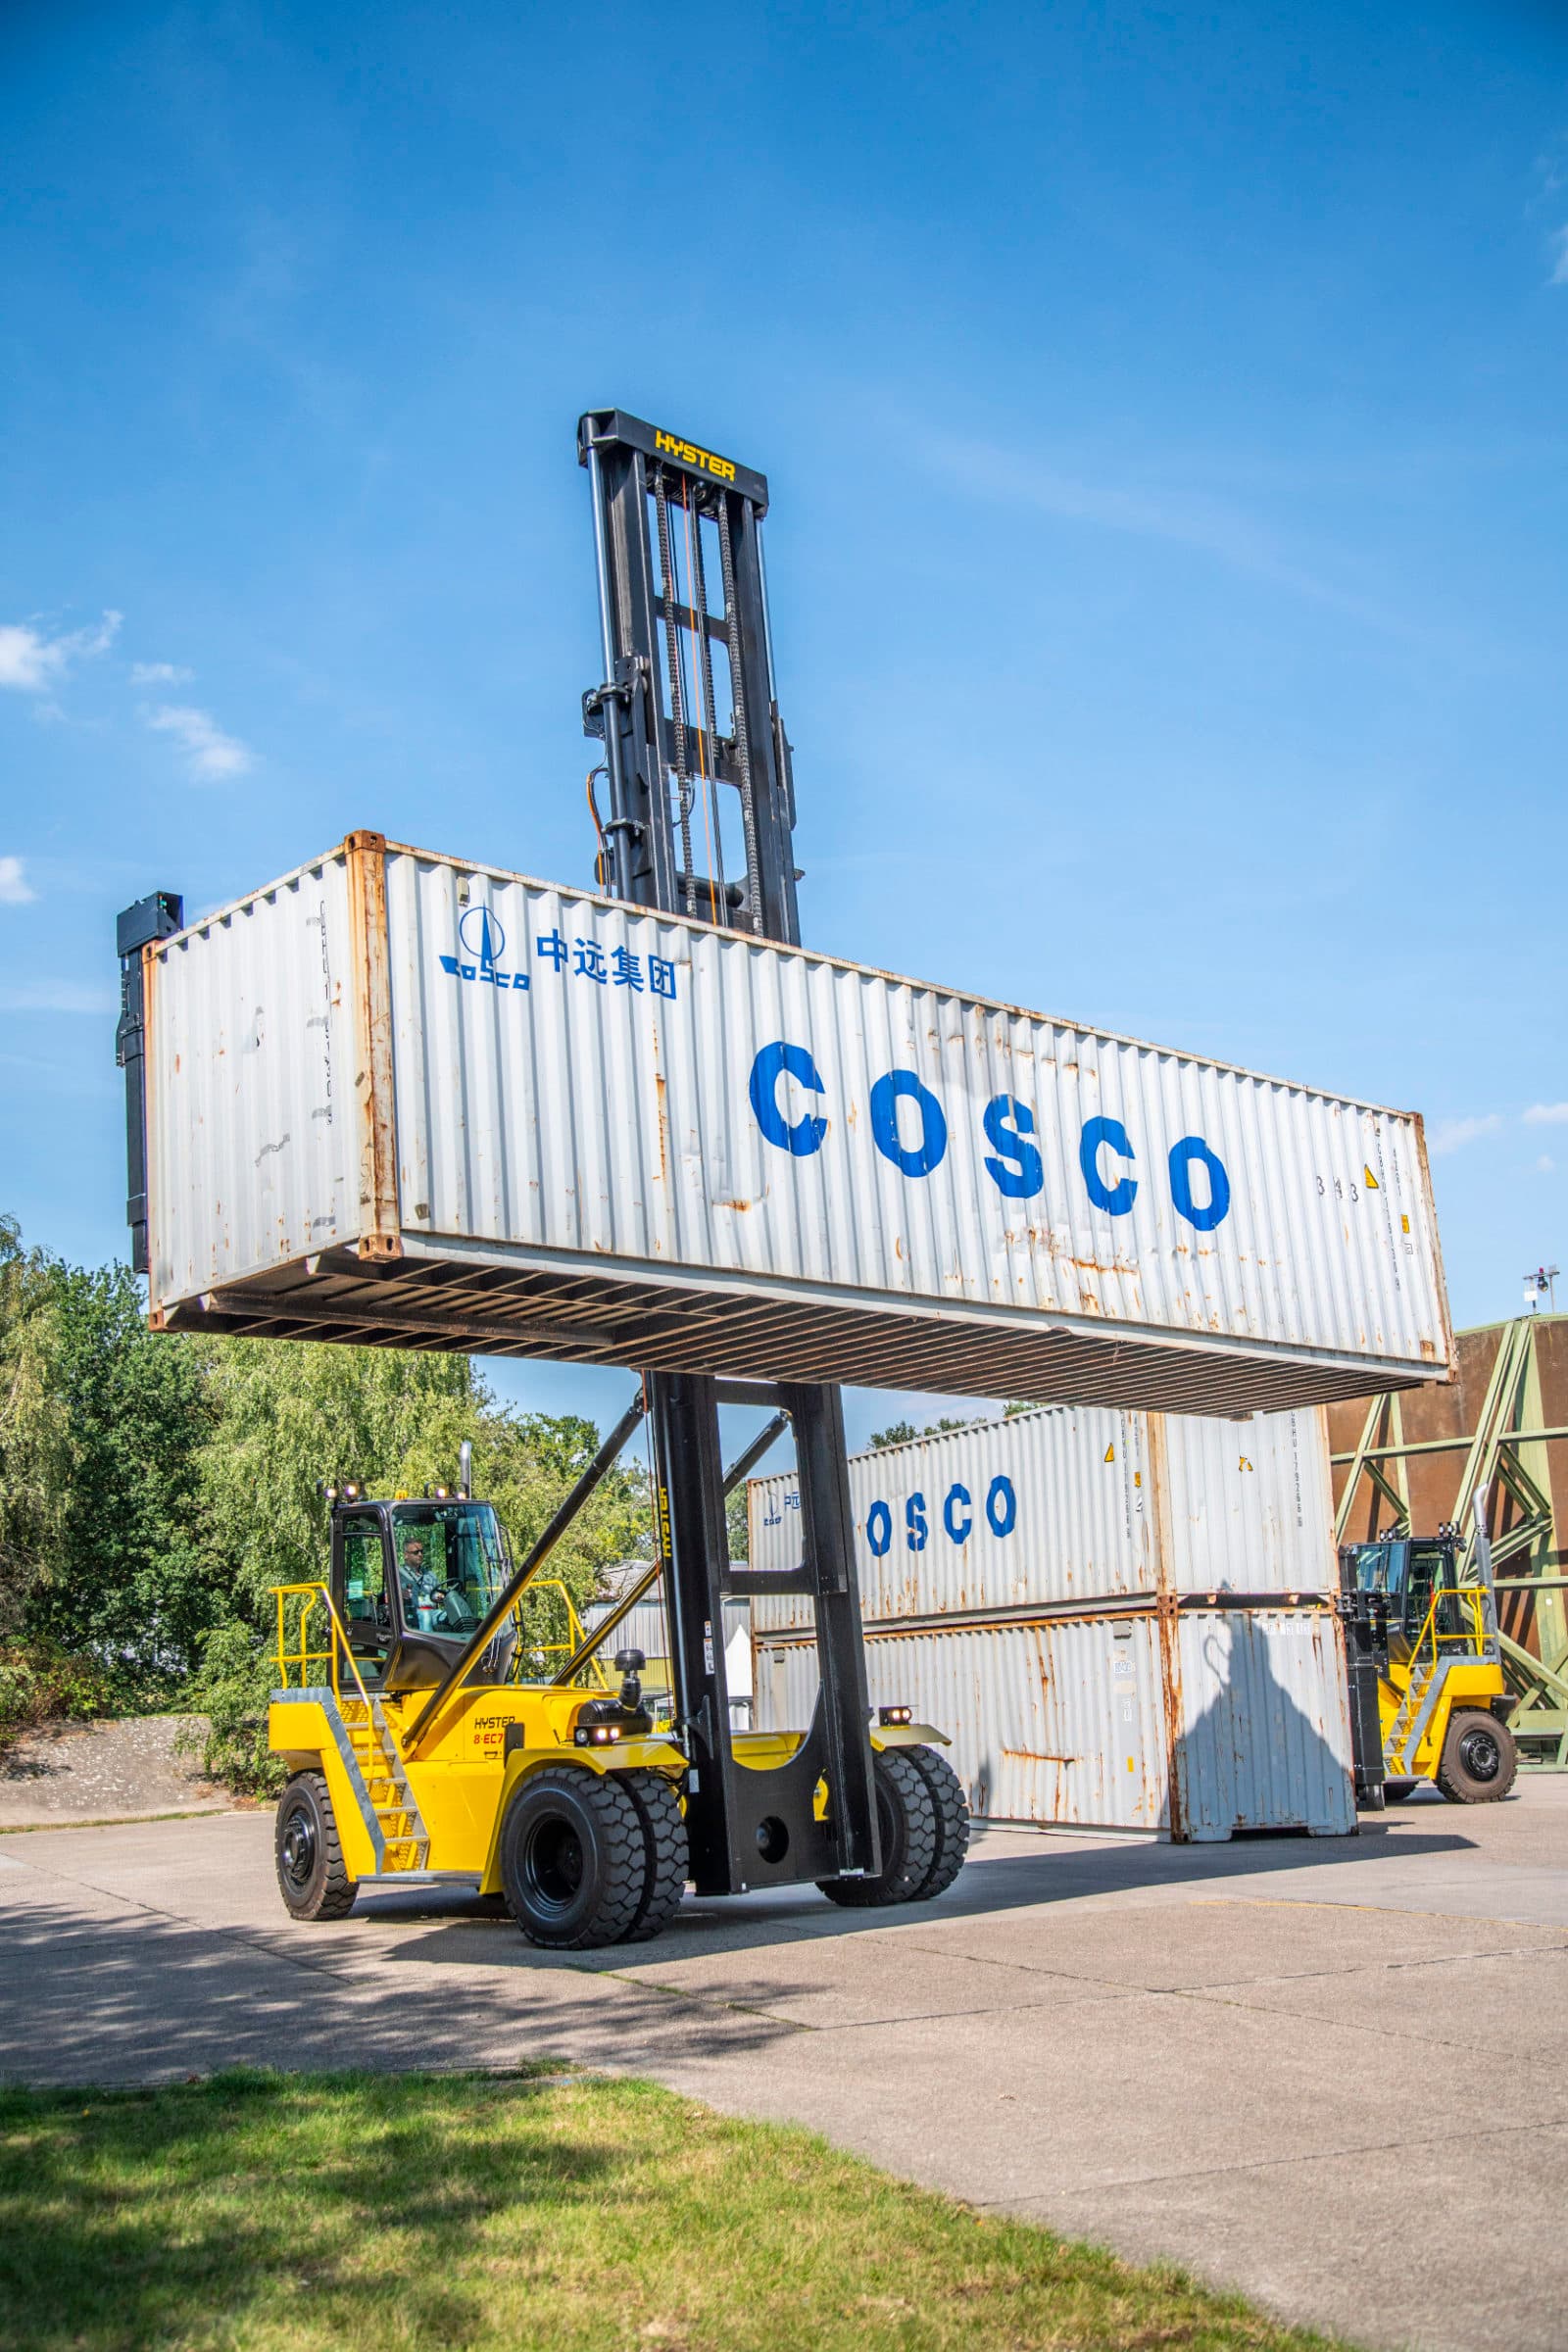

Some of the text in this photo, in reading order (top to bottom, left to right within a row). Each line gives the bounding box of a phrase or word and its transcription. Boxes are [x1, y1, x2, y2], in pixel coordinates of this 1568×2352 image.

[656, 430, 736, 481] HYSTER
[536, 928, 677, 1000] 中远集团
[749, 1040, 1231, 1233] COSCO
[659, 1487, 672, 1557] HYSTER
[866, 1474, 1017, 1557] OSCO
